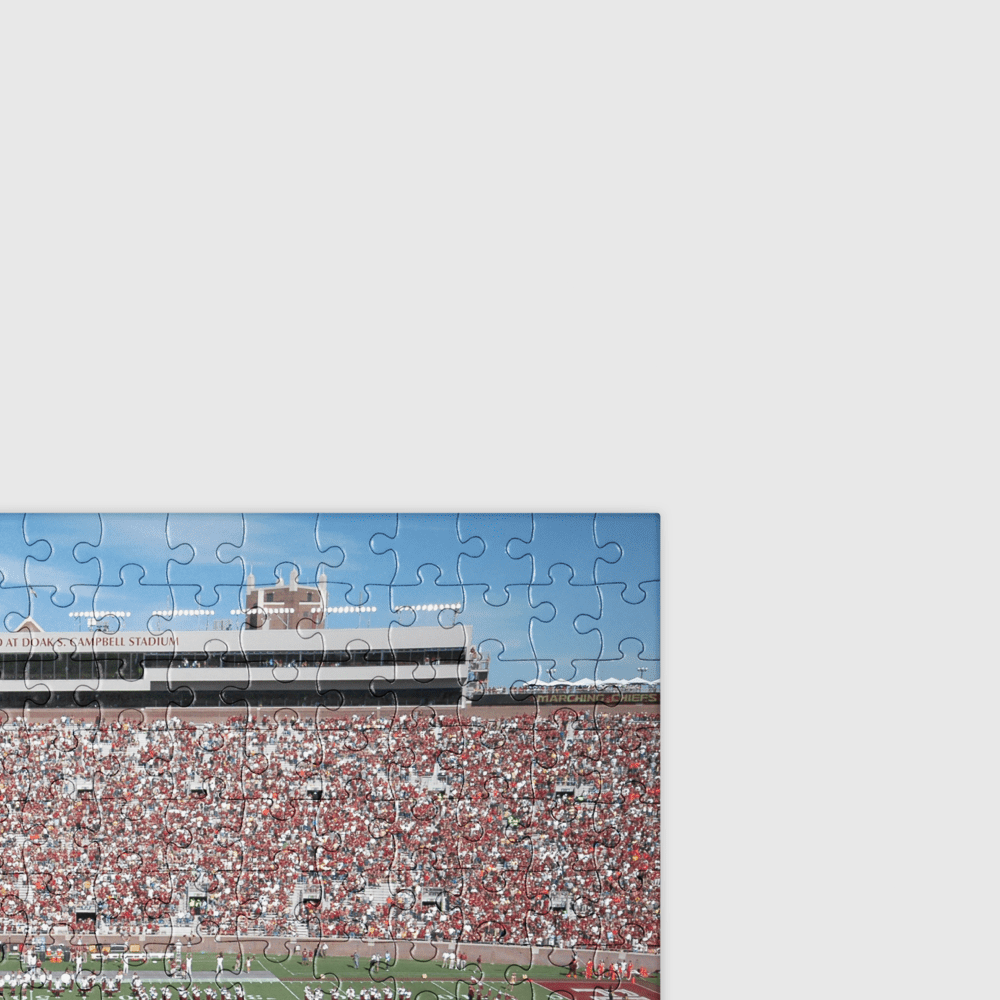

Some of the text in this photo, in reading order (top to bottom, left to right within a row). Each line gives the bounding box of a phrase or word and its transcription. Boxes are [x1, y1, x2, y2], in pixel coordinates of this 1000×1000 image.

[5, 638, 19, 647] AT
[22, 637, 54, 647] DOAK
[57, 637, 66, 647] S.
[70, 637, 126, 647] CAMPBELL
[128, 636, 179, 647] STADIUM
[537, 693, 658, 703] MARCHING CHIEFS
